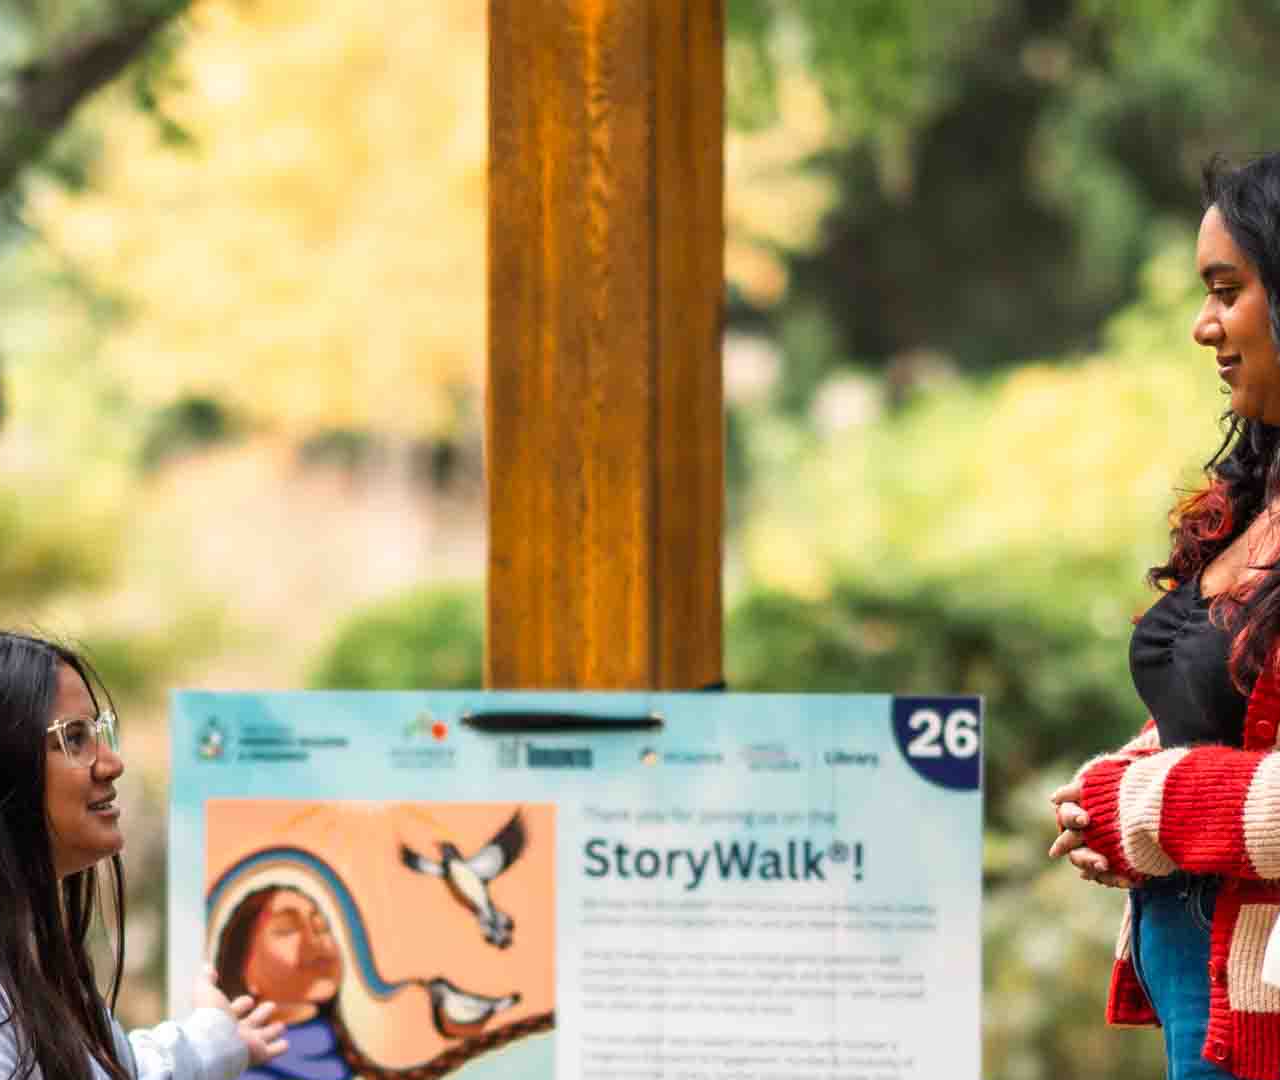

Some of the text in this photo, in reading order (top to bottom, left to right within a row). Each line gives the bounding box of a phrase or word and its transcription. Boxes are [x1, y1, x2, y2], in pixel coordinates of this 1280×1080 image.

[823, 749, 879, 768] Library
[908, 708, 978, 759] 26
[584, 838, 865, 891] StoryWalk®!
